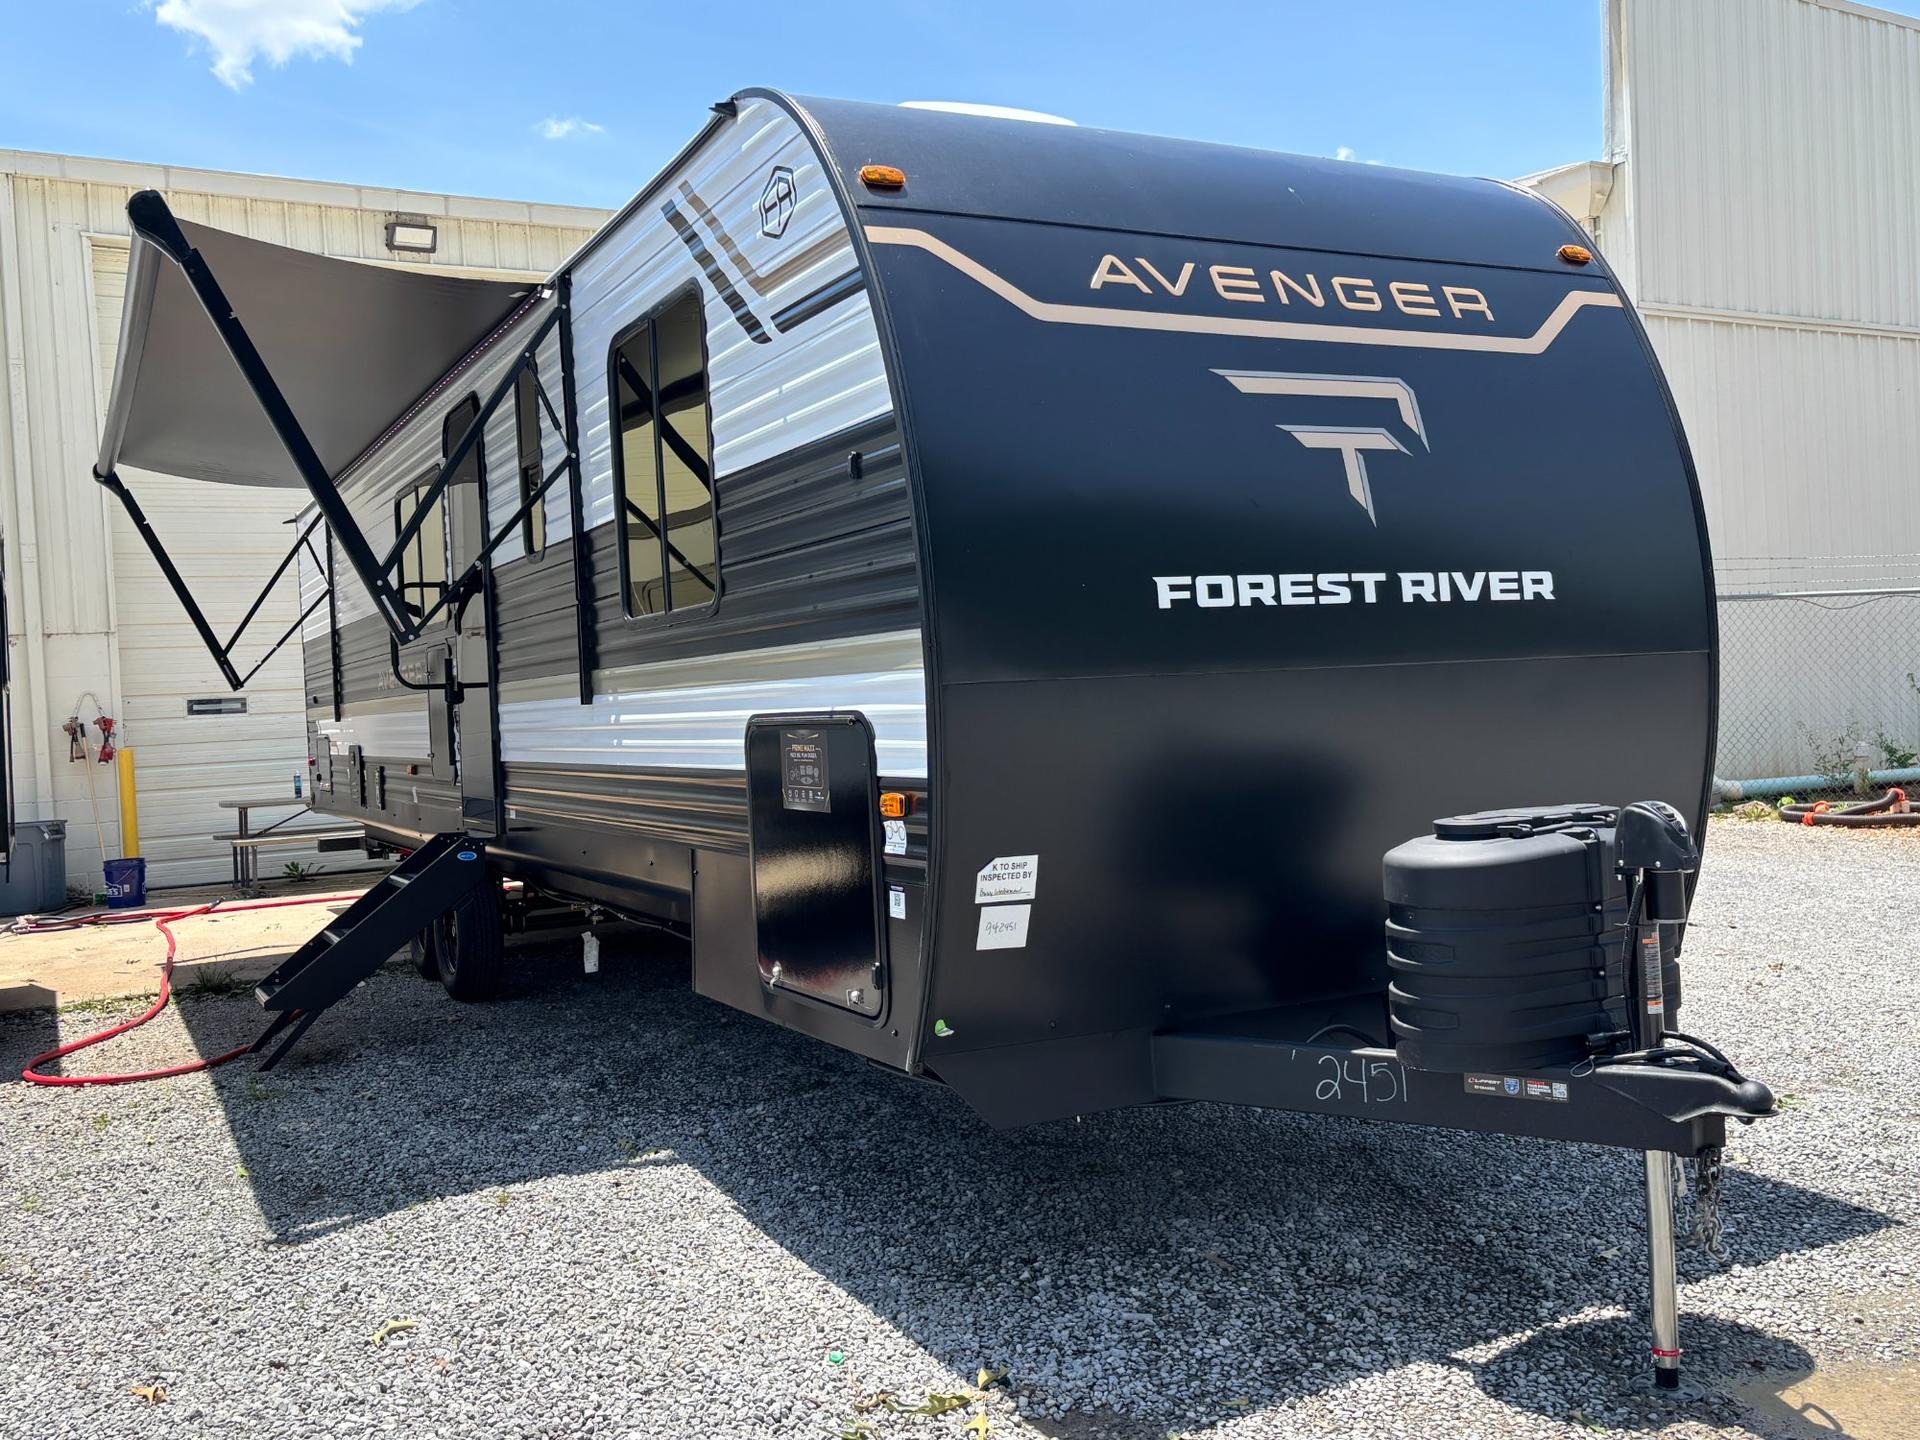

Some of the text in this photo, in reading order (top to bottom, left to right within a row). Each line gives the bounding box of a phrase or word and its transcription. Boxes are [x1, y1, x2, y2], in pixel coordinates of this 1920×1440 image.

[1090, 253, 1496, 322] AVENGER
[1152, 570, 1556, 609] FOREST RIVER
[981, 871, 1032, 882] INSPECTED BY
[1011, 862, 1027, 870] SHIP
[1315, 1055, 1408, 1103] 2451
